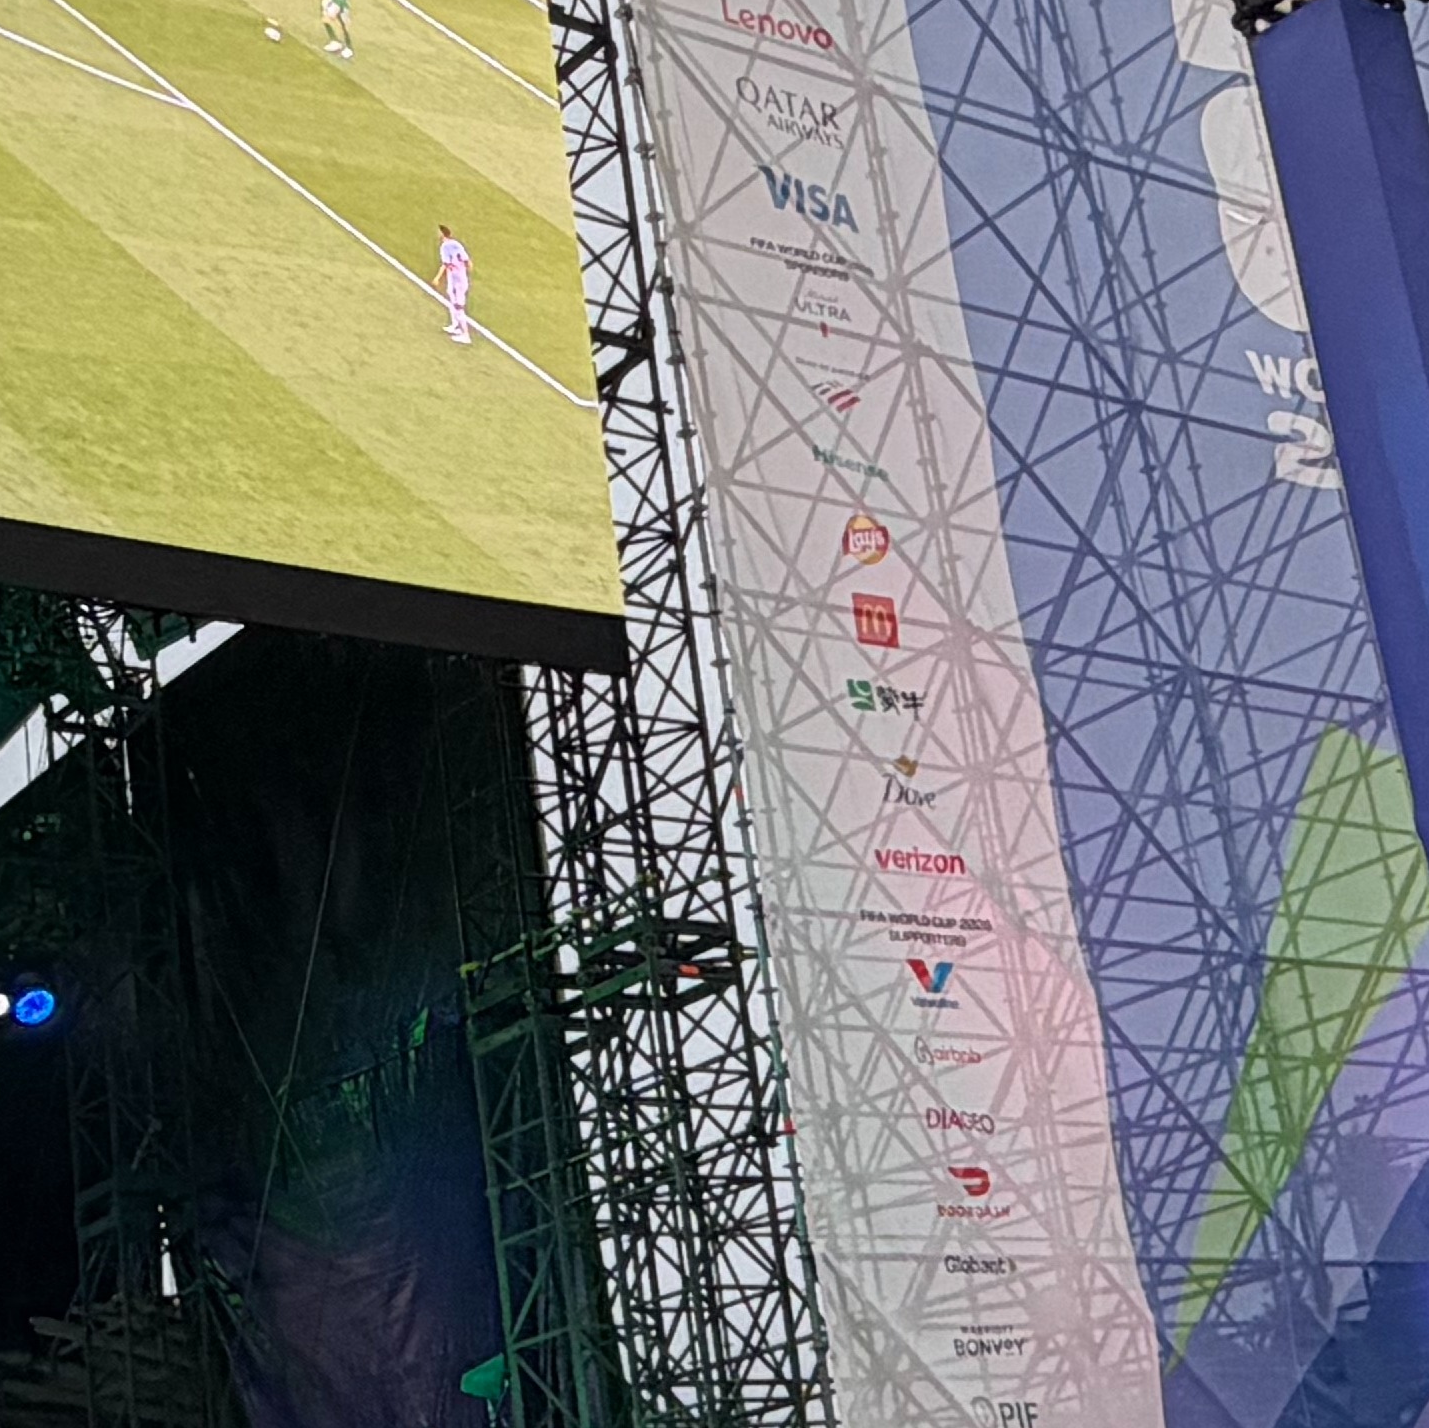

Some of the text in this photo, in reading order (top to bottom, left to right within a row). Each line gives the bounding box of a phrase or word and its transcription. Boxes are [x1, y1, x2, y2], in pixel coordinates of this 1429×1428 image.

[736, 76, 841, 131] QATAR
[767, 113, 845, 150] AIRWAYS
[757, 164, 859, 234] VISA
[882, 774, 937, 810] Dove
[874, 846, 965, 875] verizon
[925, 1107, 995, 1136] DIAGEO
